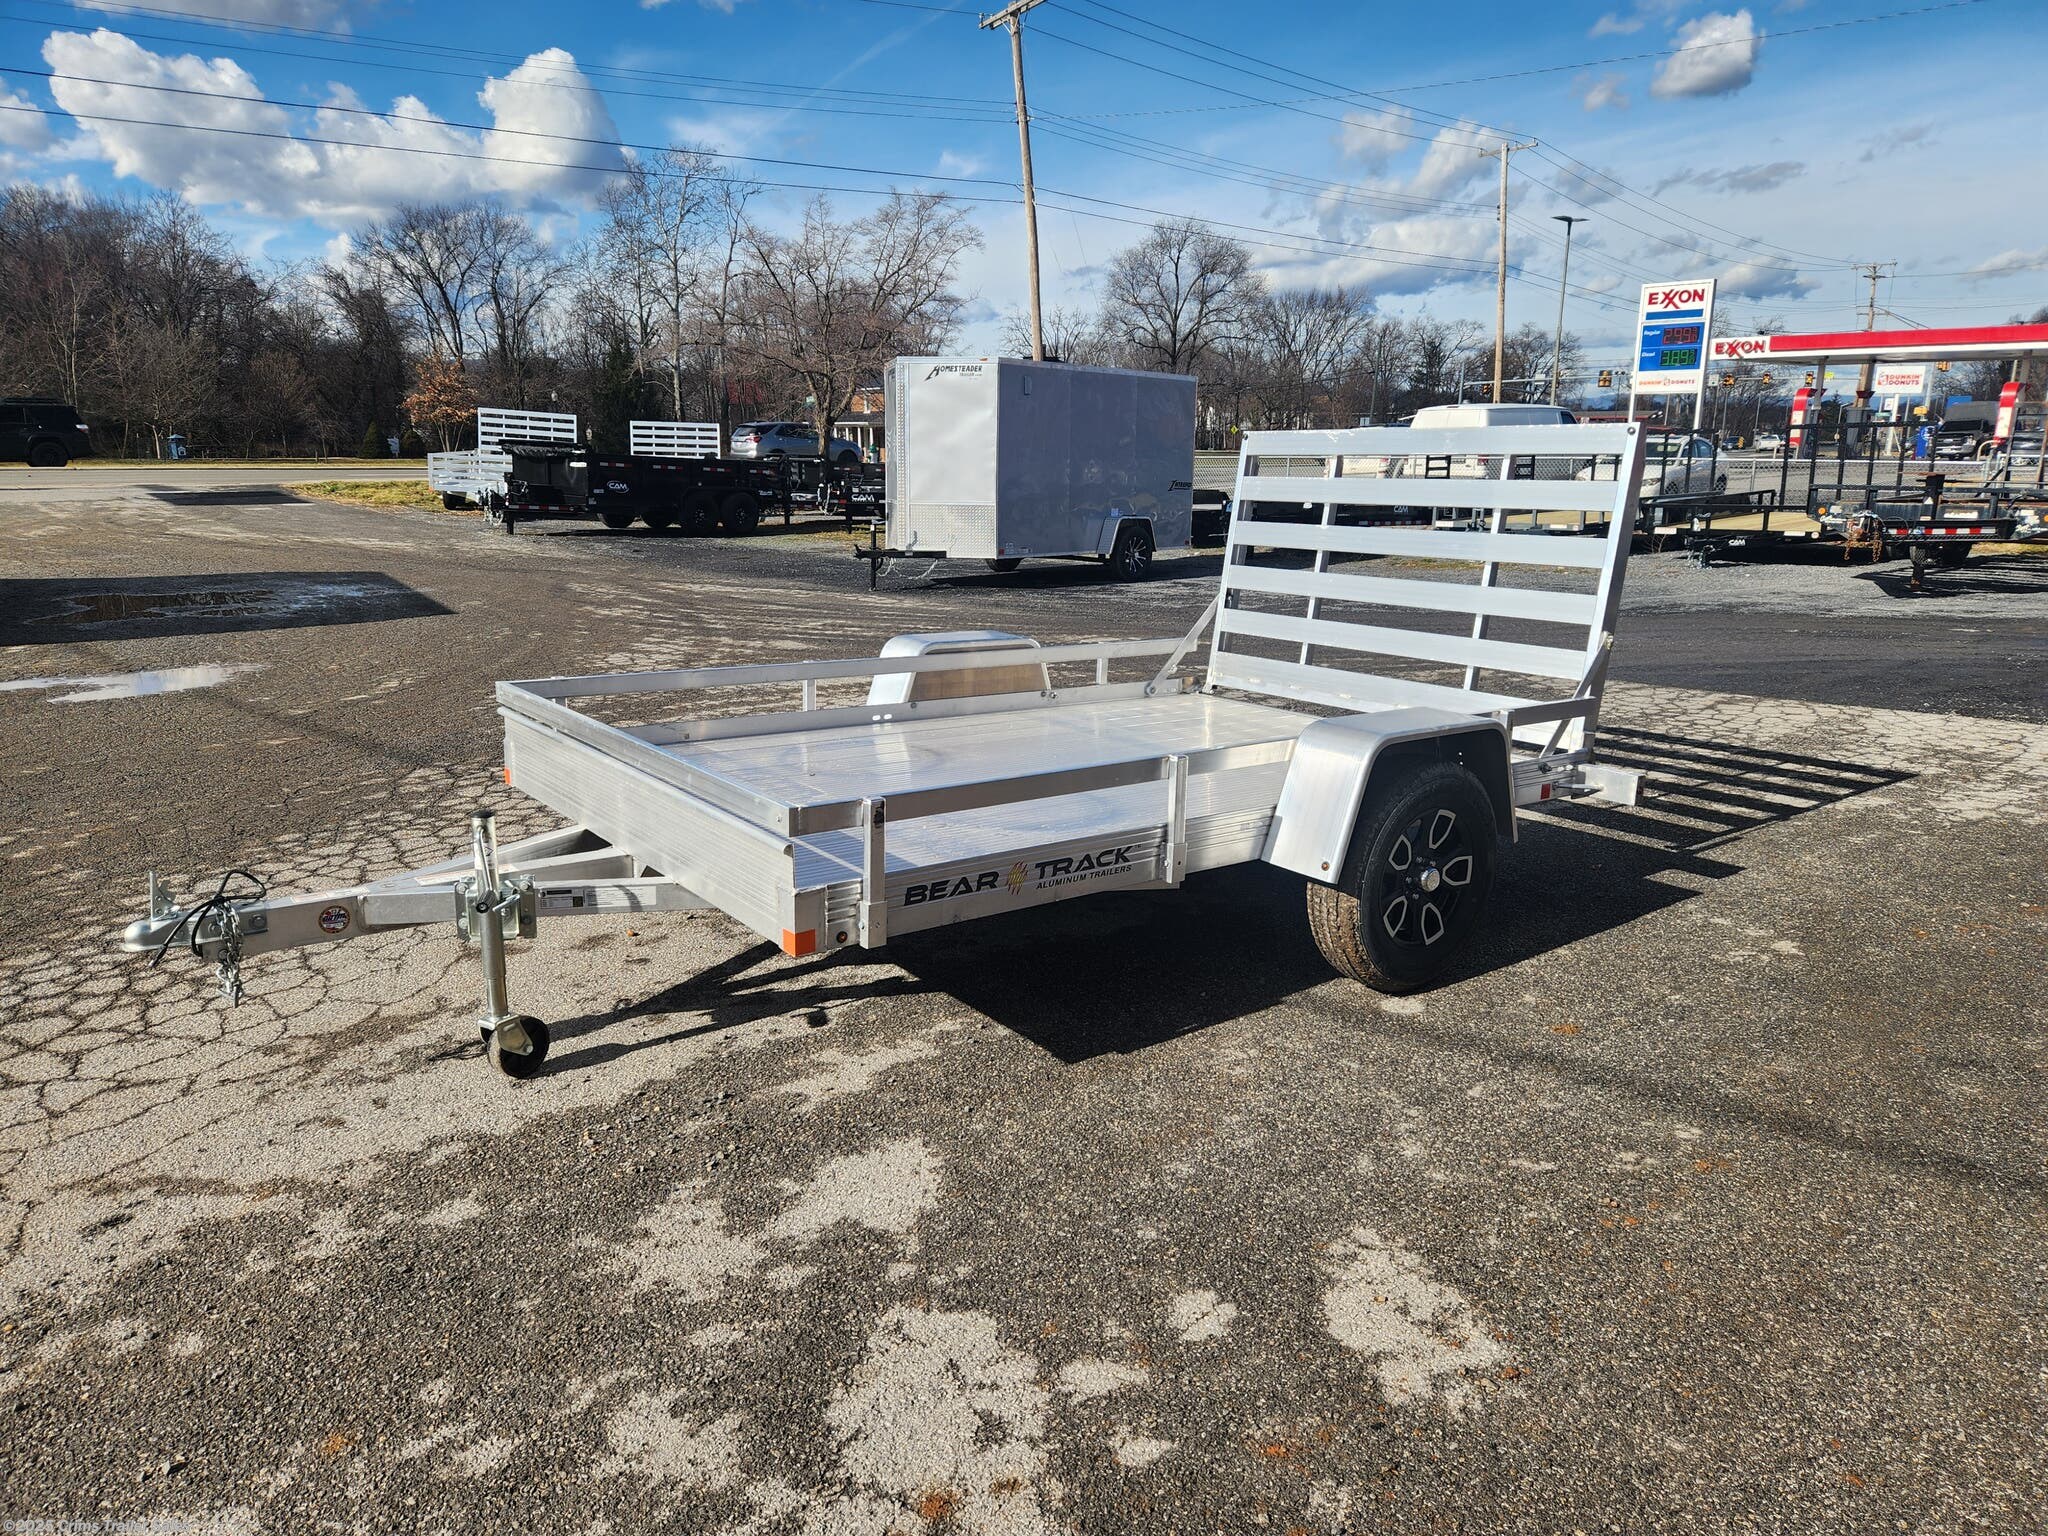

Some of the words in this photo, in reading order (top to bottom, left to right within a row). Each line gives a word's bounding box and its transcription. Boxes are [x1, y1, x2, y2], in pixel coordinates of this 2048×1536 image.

[1648, 288, 1705, 309] EXXON
[1715, 339, 1765, 358] EXXON
[924, 365, 983, 381] HOMESTEADER
[851, 494, 875, 502] CAM
[903, 870, 1000, 907] BEAR
[1034, 845, 1133, 880] TRACK
[1036, 873, 1087, 890] ALUMINUM
[1089, 864, 1132, 879] TRAILERS
